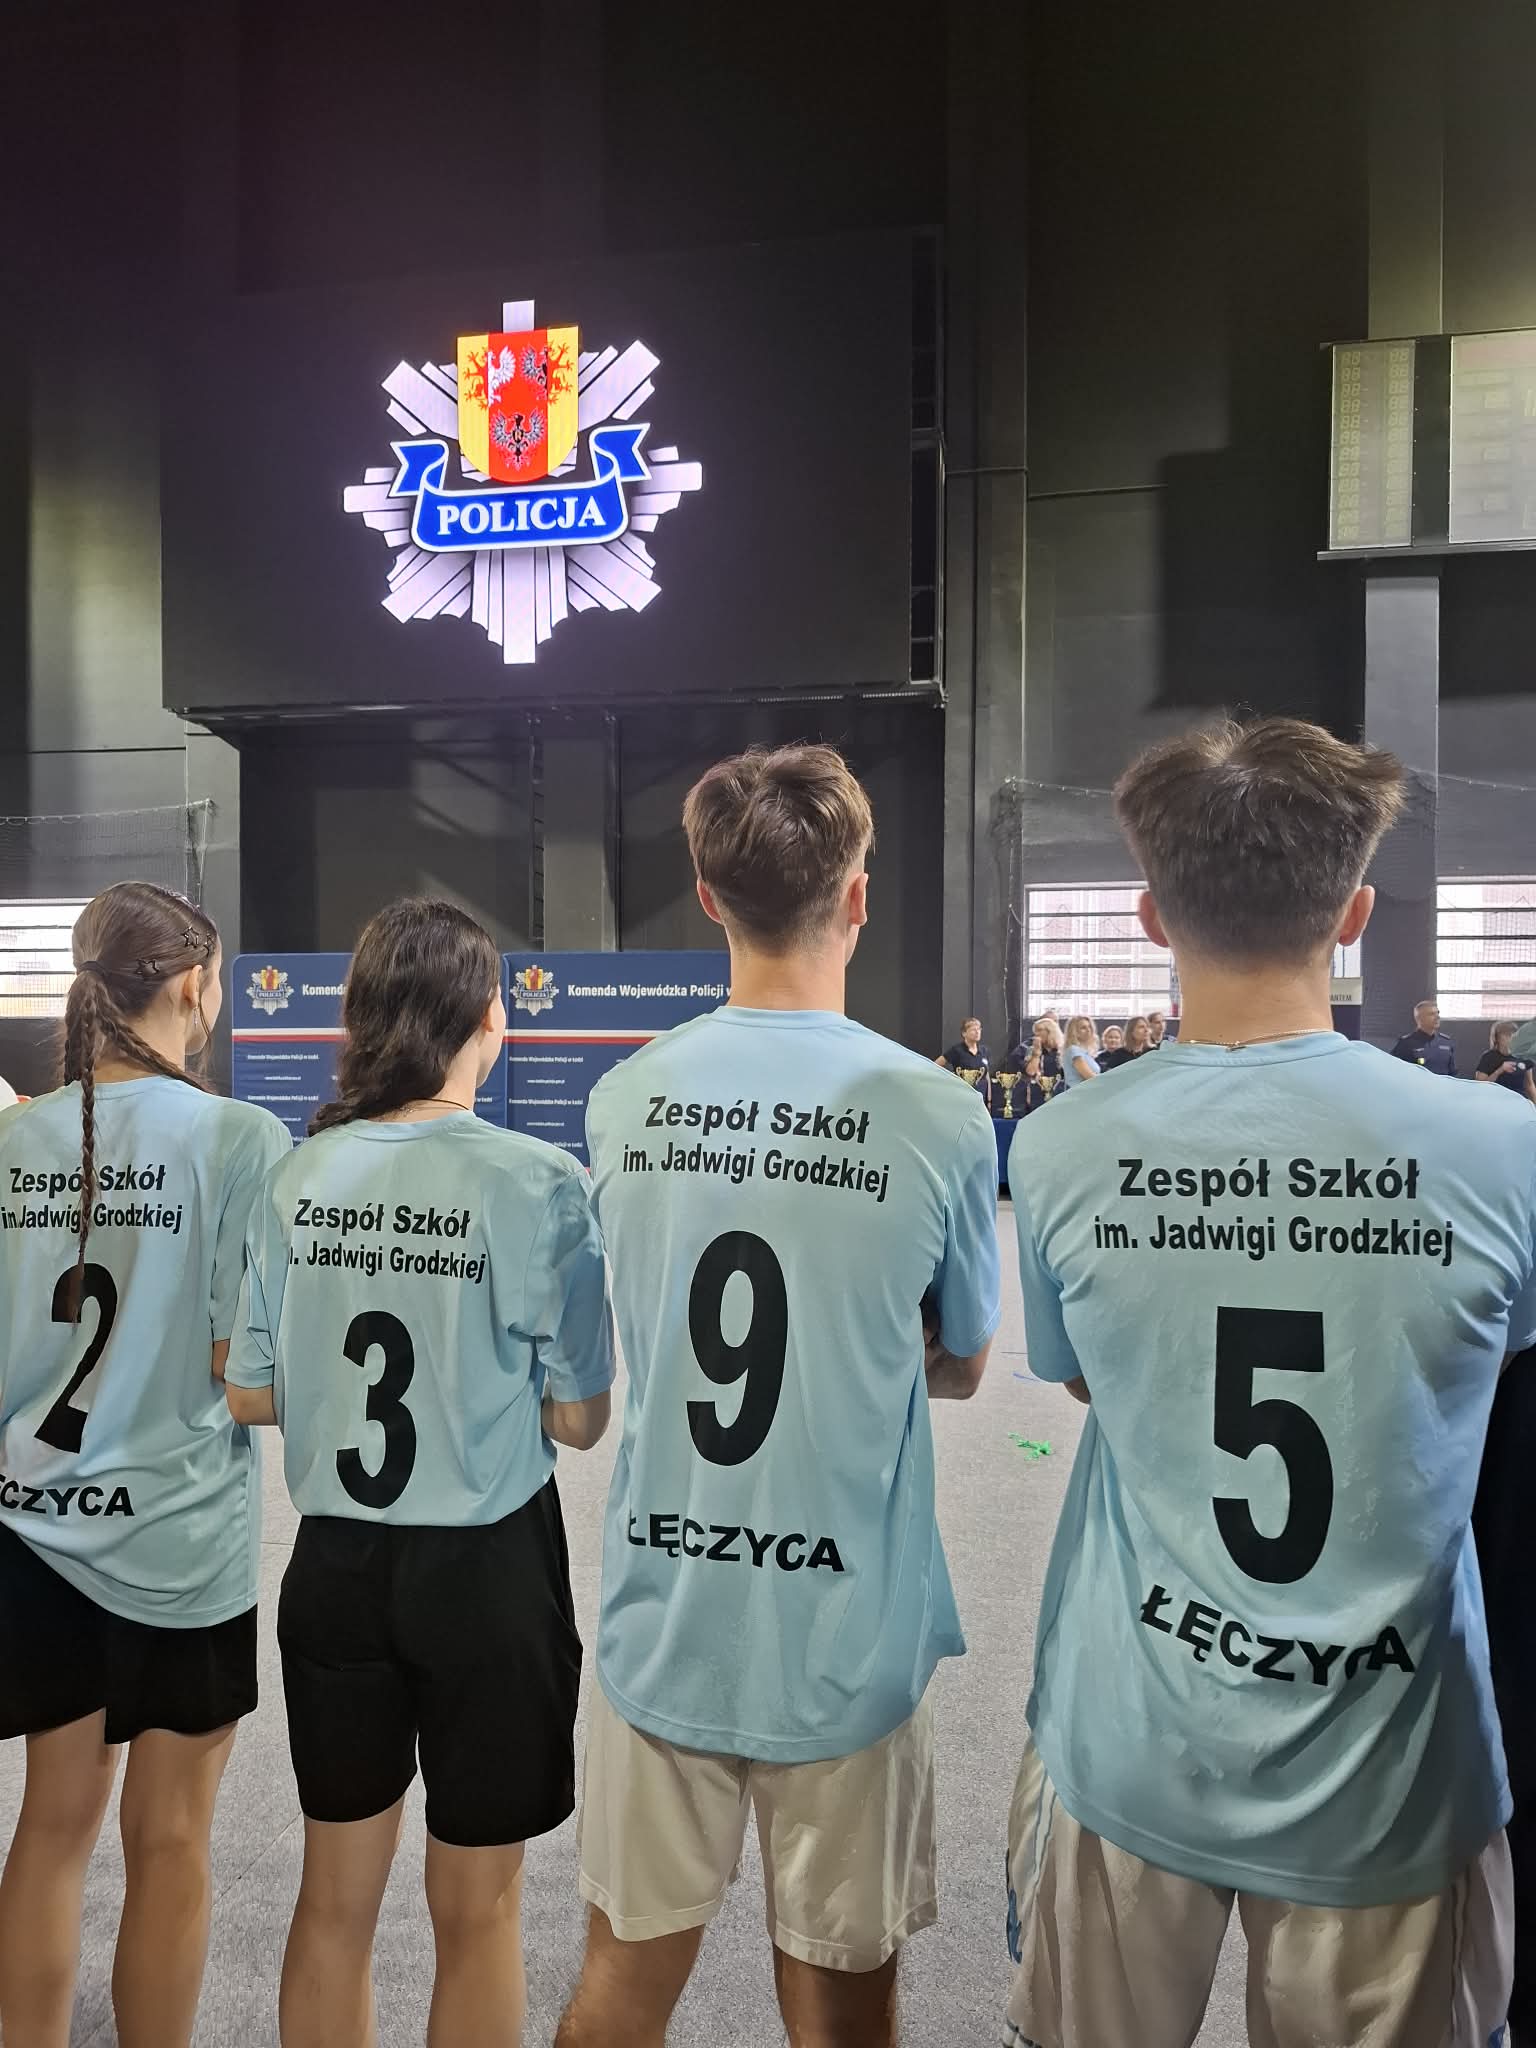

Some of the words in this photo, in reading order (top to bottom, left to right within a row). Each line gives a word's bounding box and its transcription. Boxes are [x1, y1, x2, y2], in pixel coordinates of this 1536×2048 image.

[437, 495, 606, 536] POLICJA
[568, 985, 617, 997] Komenda
[620, 984, 687, 999] Wojewódzka
[690, 984, 724, 999] Policji
[645, 1095, 759, 1136] Zespół
[770, 1102, 870, 1143] Szkół
[10, 1166, 84, 1198] Zespó
[99, 1164, 166, 1191] Szkół
[623, 1144, 653, 1172] im.
[661, 1142, 756, 1184] Jadwigi
[764, 1150, 889, 1202] Grodzkiej
[1118, 1158, 1270, 1206] Zespół
[1288, 1158, 1420, 1199] Szkół
[1, 1206, 17, 1228] im
[19, 1205, 82, 1233] Jadwig
[94, 1203, 183, 1234] Grodzkiej
[294, 1198, 385, 1236] Zespół
[392, 1205, 471, 1238] Szkół
[1094, 1215, 1138, 1249] im.
[1149, 1215, 1275, 1261] Jadwigi
[1288, 1216, 1453, 1266] Grodzkiej
[307, 1240, 383, 1277] Jadwigi
[390, 1246, 486, 1284] Grodzkiej
[34, 1262, 118, 1454] 2
[686, 1230, 788, 1466] 9
[336, 1310, 417, 1510] 3
[1212, 1306, 1334, 1585] 5
[628, 1513, 845, 1573] ŁĘCZYCA
